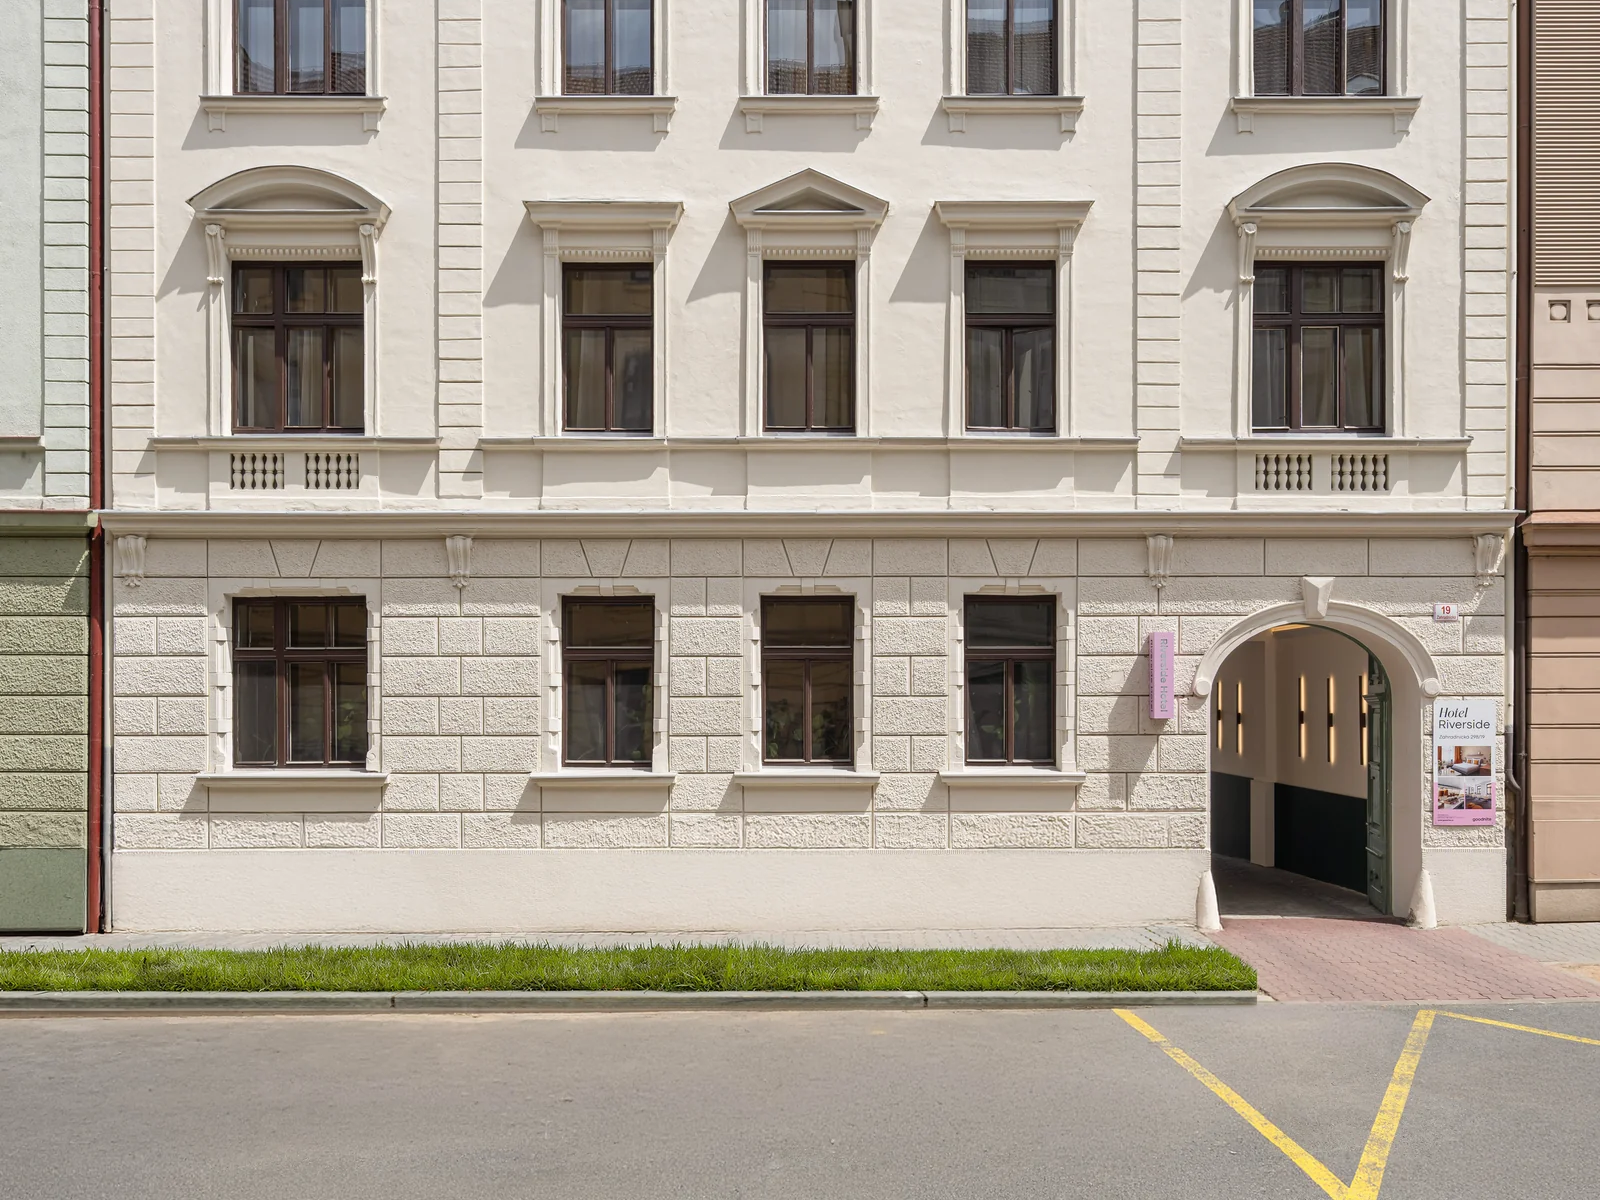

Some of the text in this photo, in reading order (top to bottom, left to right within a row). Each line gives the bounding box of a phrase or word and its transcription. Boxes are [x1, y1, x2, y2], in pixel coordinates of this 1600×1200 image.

[1441, 605, 1451, 614] 19
[1160, 638, 1168, 712] Riverside Hotel
[1439, 707, 1469, 718] Hotel
[1438, 719, 1491, 729] Riverside
